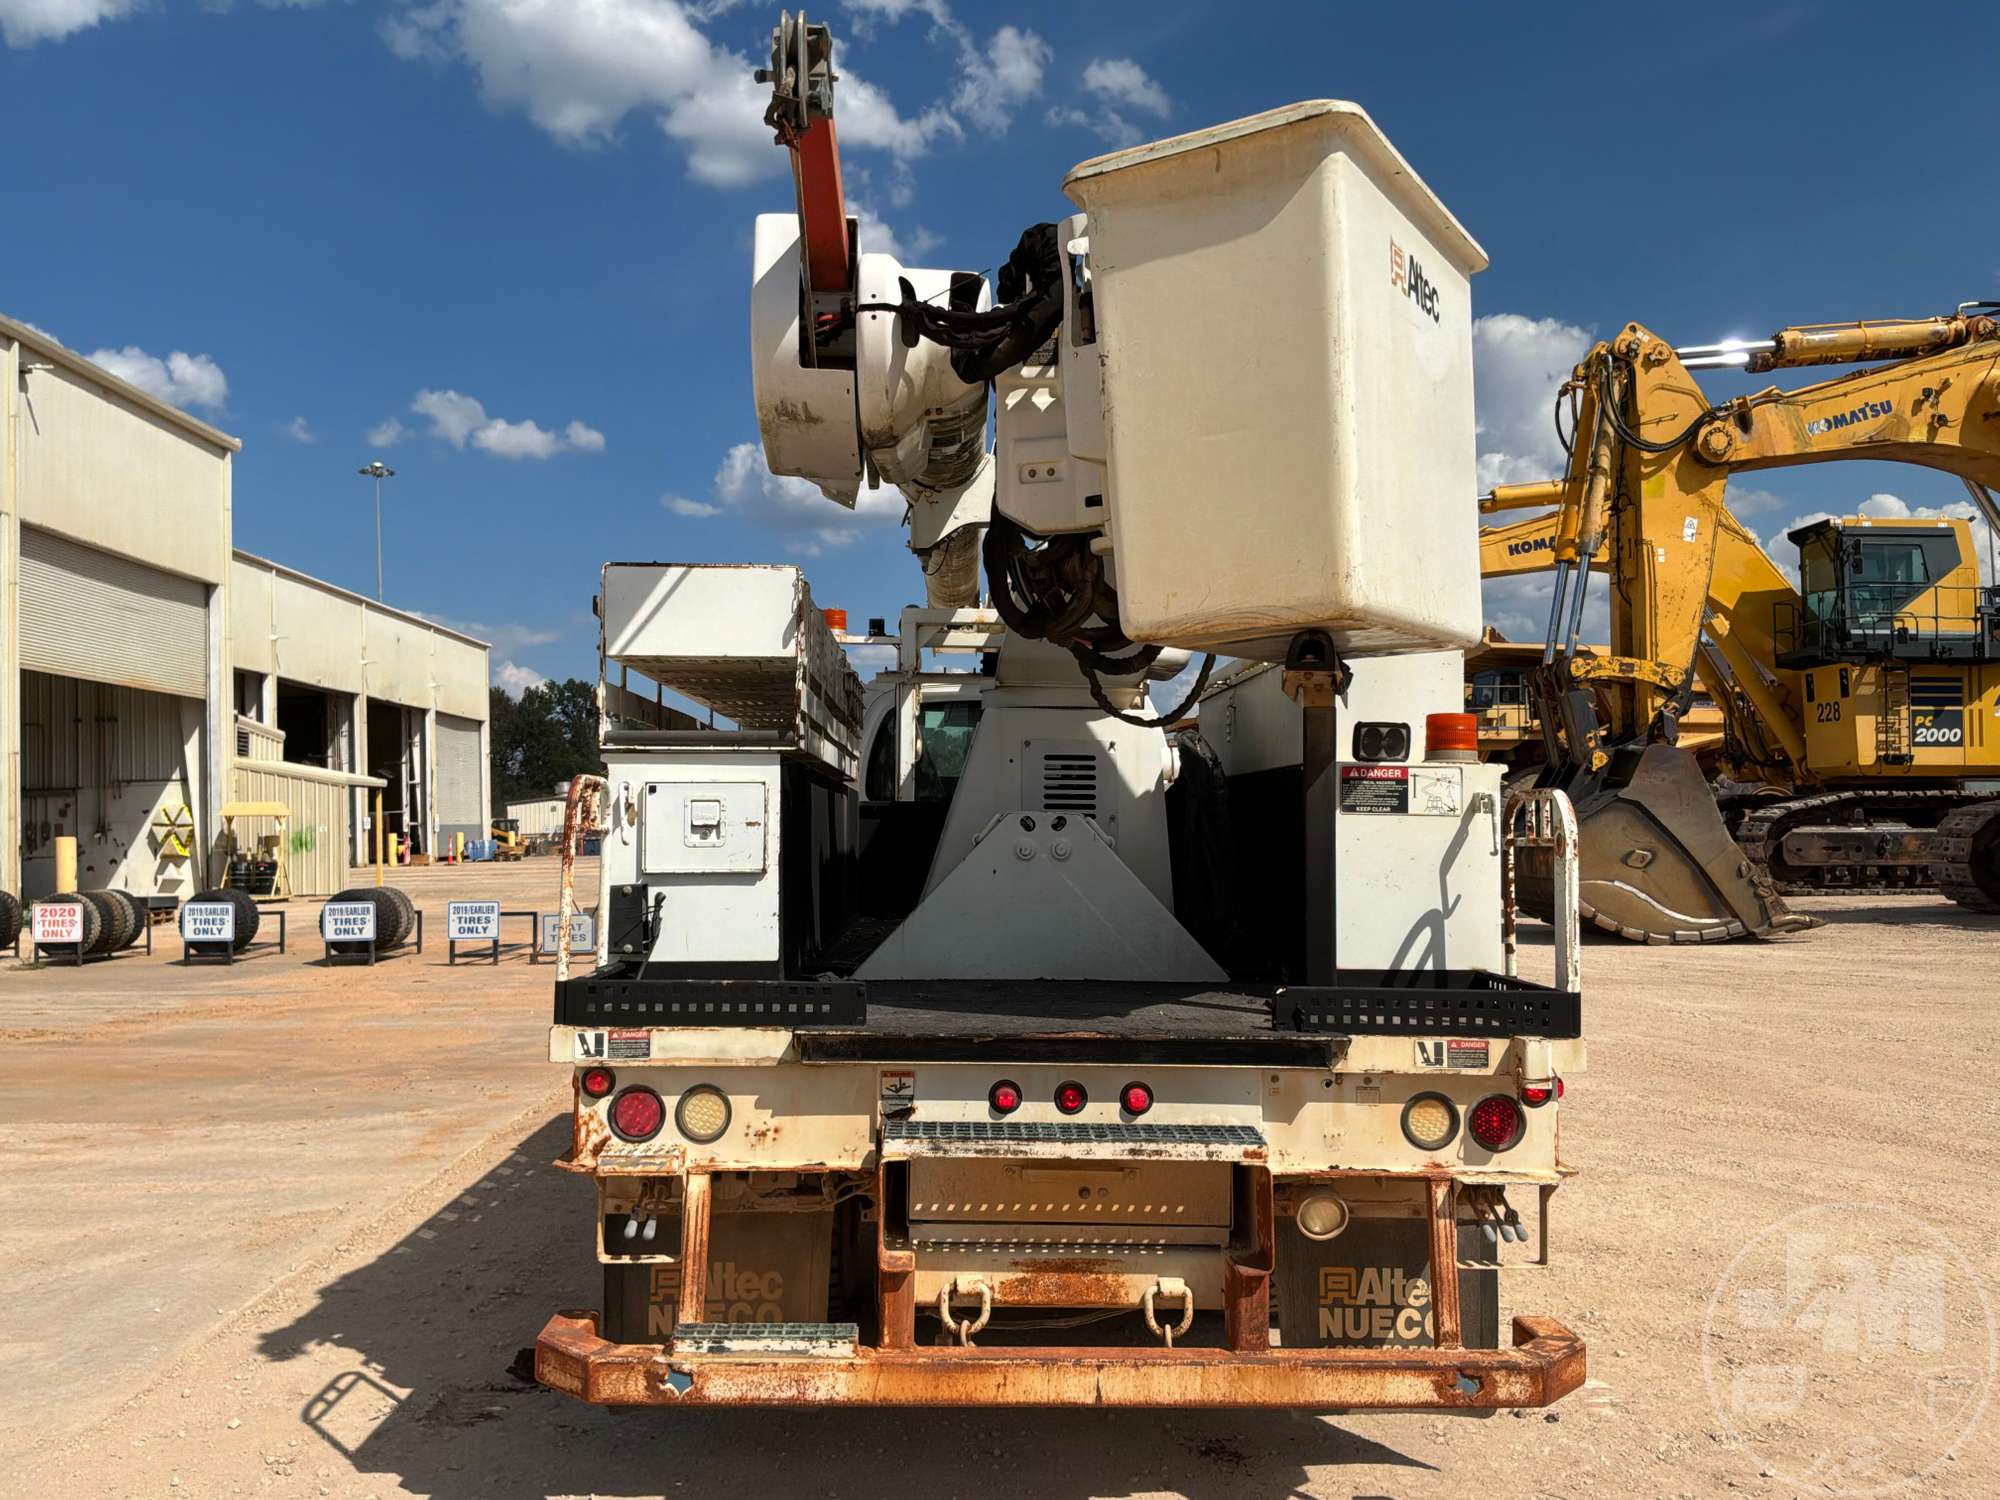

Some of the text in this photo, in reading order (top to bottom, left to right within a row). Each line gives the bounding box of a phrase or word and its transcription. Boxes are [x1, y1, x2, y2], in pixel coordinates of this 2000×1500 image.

[1408, 254, 1440, 323] Altec
[1807, 400, 1893, 435] KOMATSU
[1508, 536, 1557, 556] KOMA
[1817, 701, 1841, 723] 228
[1914, 715, 1934, 727] PC
[1914, 727, 1962, 743] 2000
[1360, 768, 1401, 778] DANGER
[39, 907, 76, 917] 2020
[187, 907, 230, 917] 2019/EARLIER
[328, 906, 371, 916] 2019/EARLIER
[452, 905, 496, 915] 2019/EARLIER
[40, 919, 76, 928] TIRES
[191, 918, 225, 926] TIRES
[333, 917, 367, 926] TIRES
[457, 916, 491, 925] TIRES
[193, 927, 223, 936] ONLY
[334, 927, 365, 936] ONLY
[458, 926, 489, 934] ONLY
[552, 923, 583, 932] FAT
[42, 928, 73, 938] ONLY
[551, 933, 587, 942] TES
[1356, 1267, 1432, 1307] Alte
